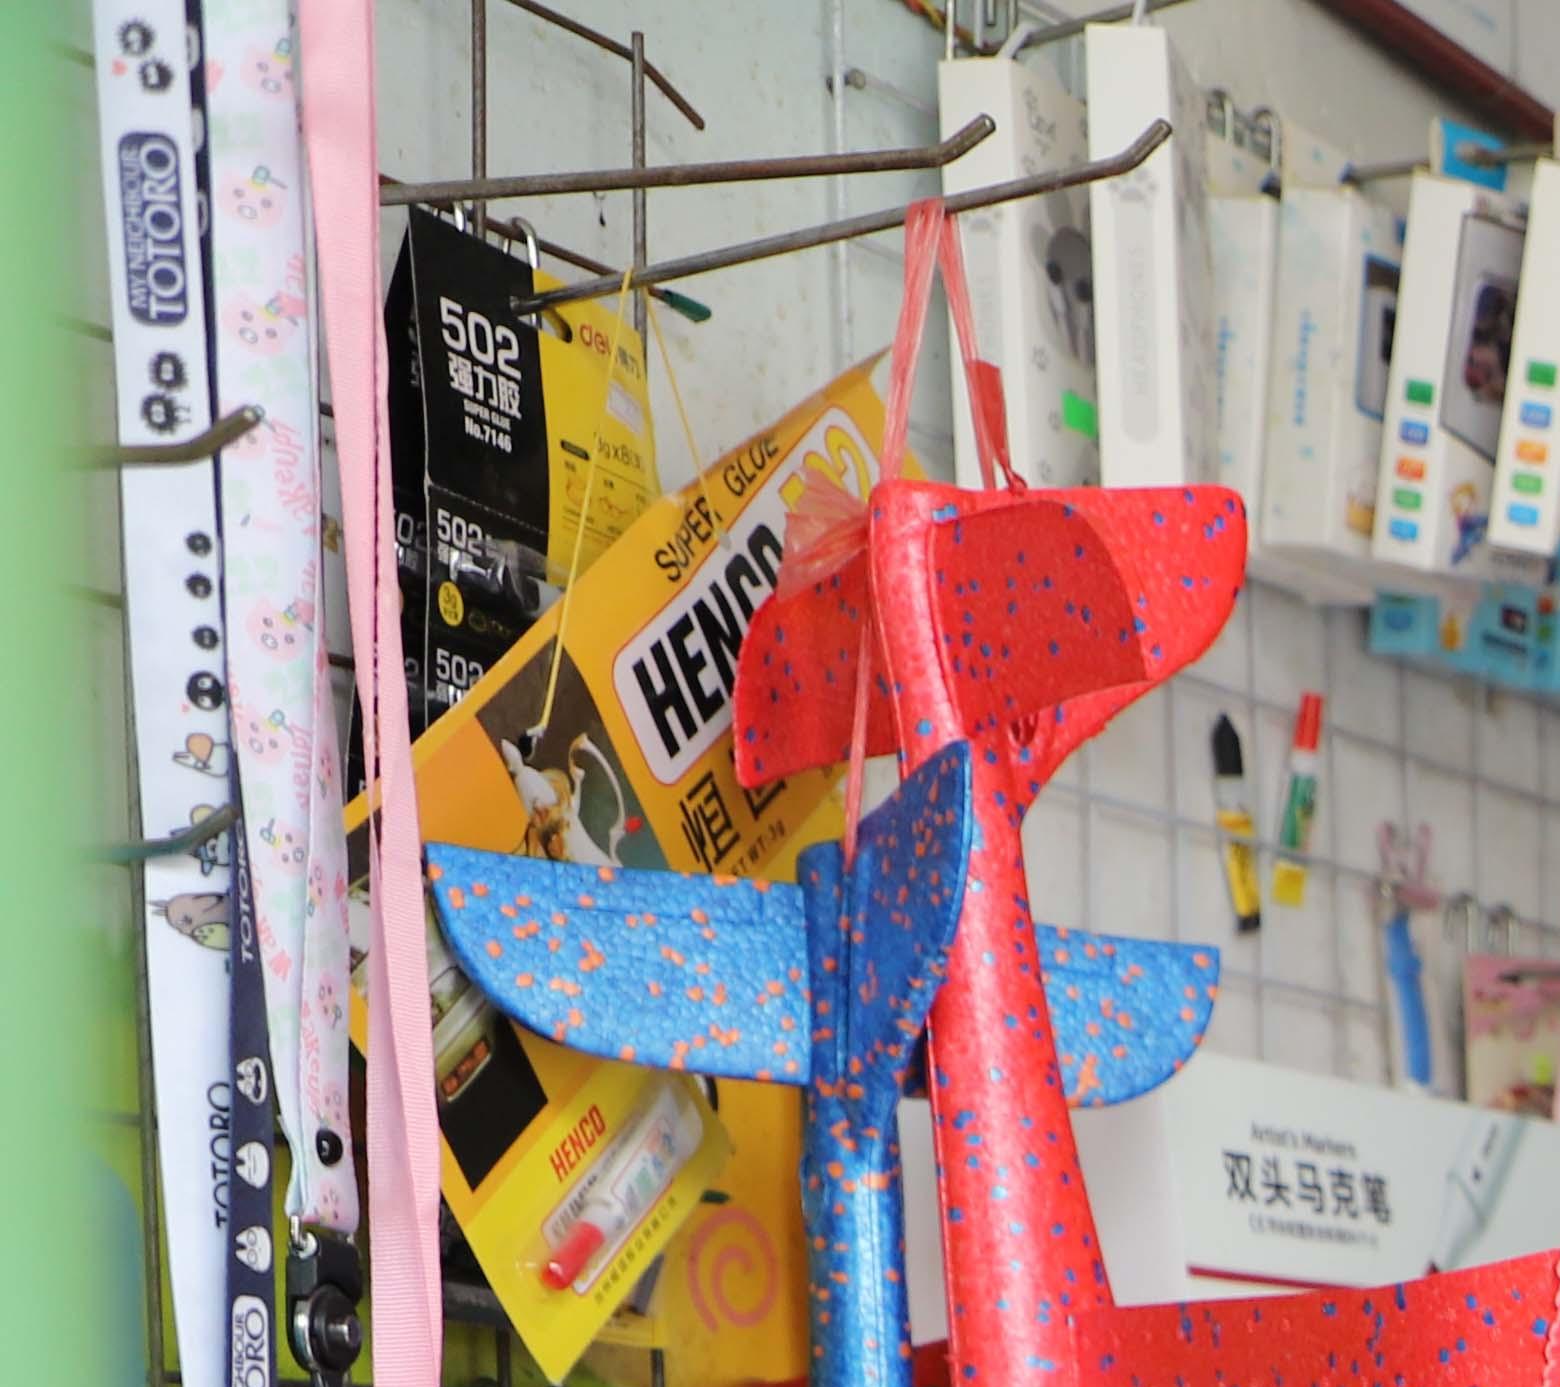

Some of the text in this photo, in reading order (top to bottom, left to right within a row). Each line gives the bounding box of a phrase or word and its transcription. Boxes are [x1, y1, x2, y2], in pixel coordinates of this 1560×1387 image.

[139, 142, 187, 321] TOTORO
[131, 273, 148, 308] MY
[440, 297, 522, 380] 502
[447, 352, 522, 420] 强力胶
[464, 416, 512, 453] No.7146
[437, 508, 484, 557] 502
[655, 434, 779, 582] SUPER GLUE
[550, 1103, 607, 1183] HENCO
[1222, 1149, 1391, 1225] 双头马克笔
